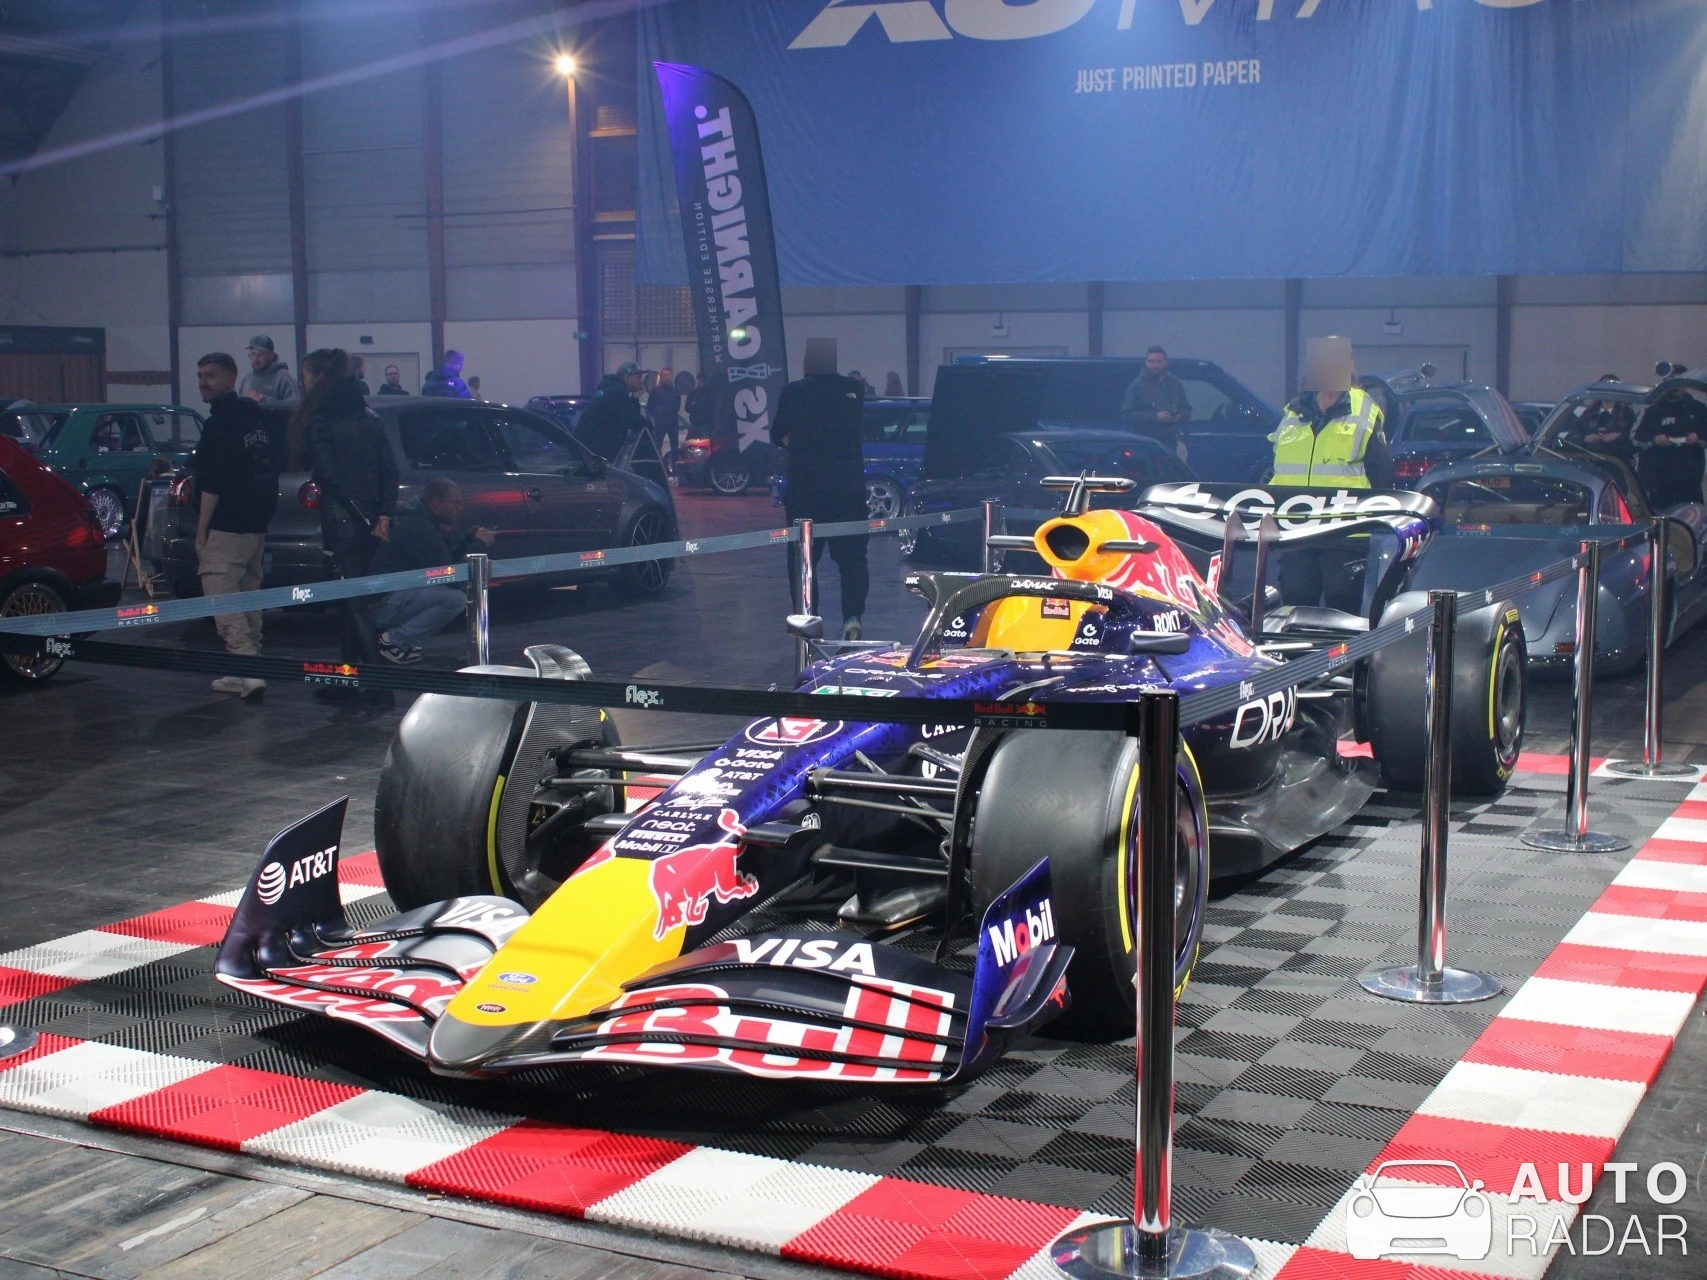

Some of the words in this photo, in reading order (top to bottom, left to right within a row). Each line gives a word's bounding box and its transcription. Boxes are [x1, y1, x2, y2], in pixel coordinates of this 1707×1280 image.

[1075, 68, 1116, 93] JUST
[1122, 63, 1198, 91] PRINTED
[1202, 59, 1261, 86] PAPER
[1223, 489, 1402, 531] Gate
[1011, 579, 1058, 590] DAMAC
[1095, 585, 1113, 600] VISA
[118, 616, 160, 626] RACING
[1075, 637, 1100, 646] Gate
[304, 676, 360, 687] RACING
[974, 718, 1047, 728] RACING
[736, 749, 784, 760] VISA
[731, 759, 775, 769] Gate
[721, 771, 764, 781] AT&T
[653, 810, 713, 820] CARLYLE
[641, 819, 696, 832] neat.
[614, 840, 662, 853] Mobil
[289, 845, 338, 889] AT&T
[988, 898, 1055, 968] Mobil
[723, 938, 876, 976] VISA
[581, 974, 956, 1083] Bull
